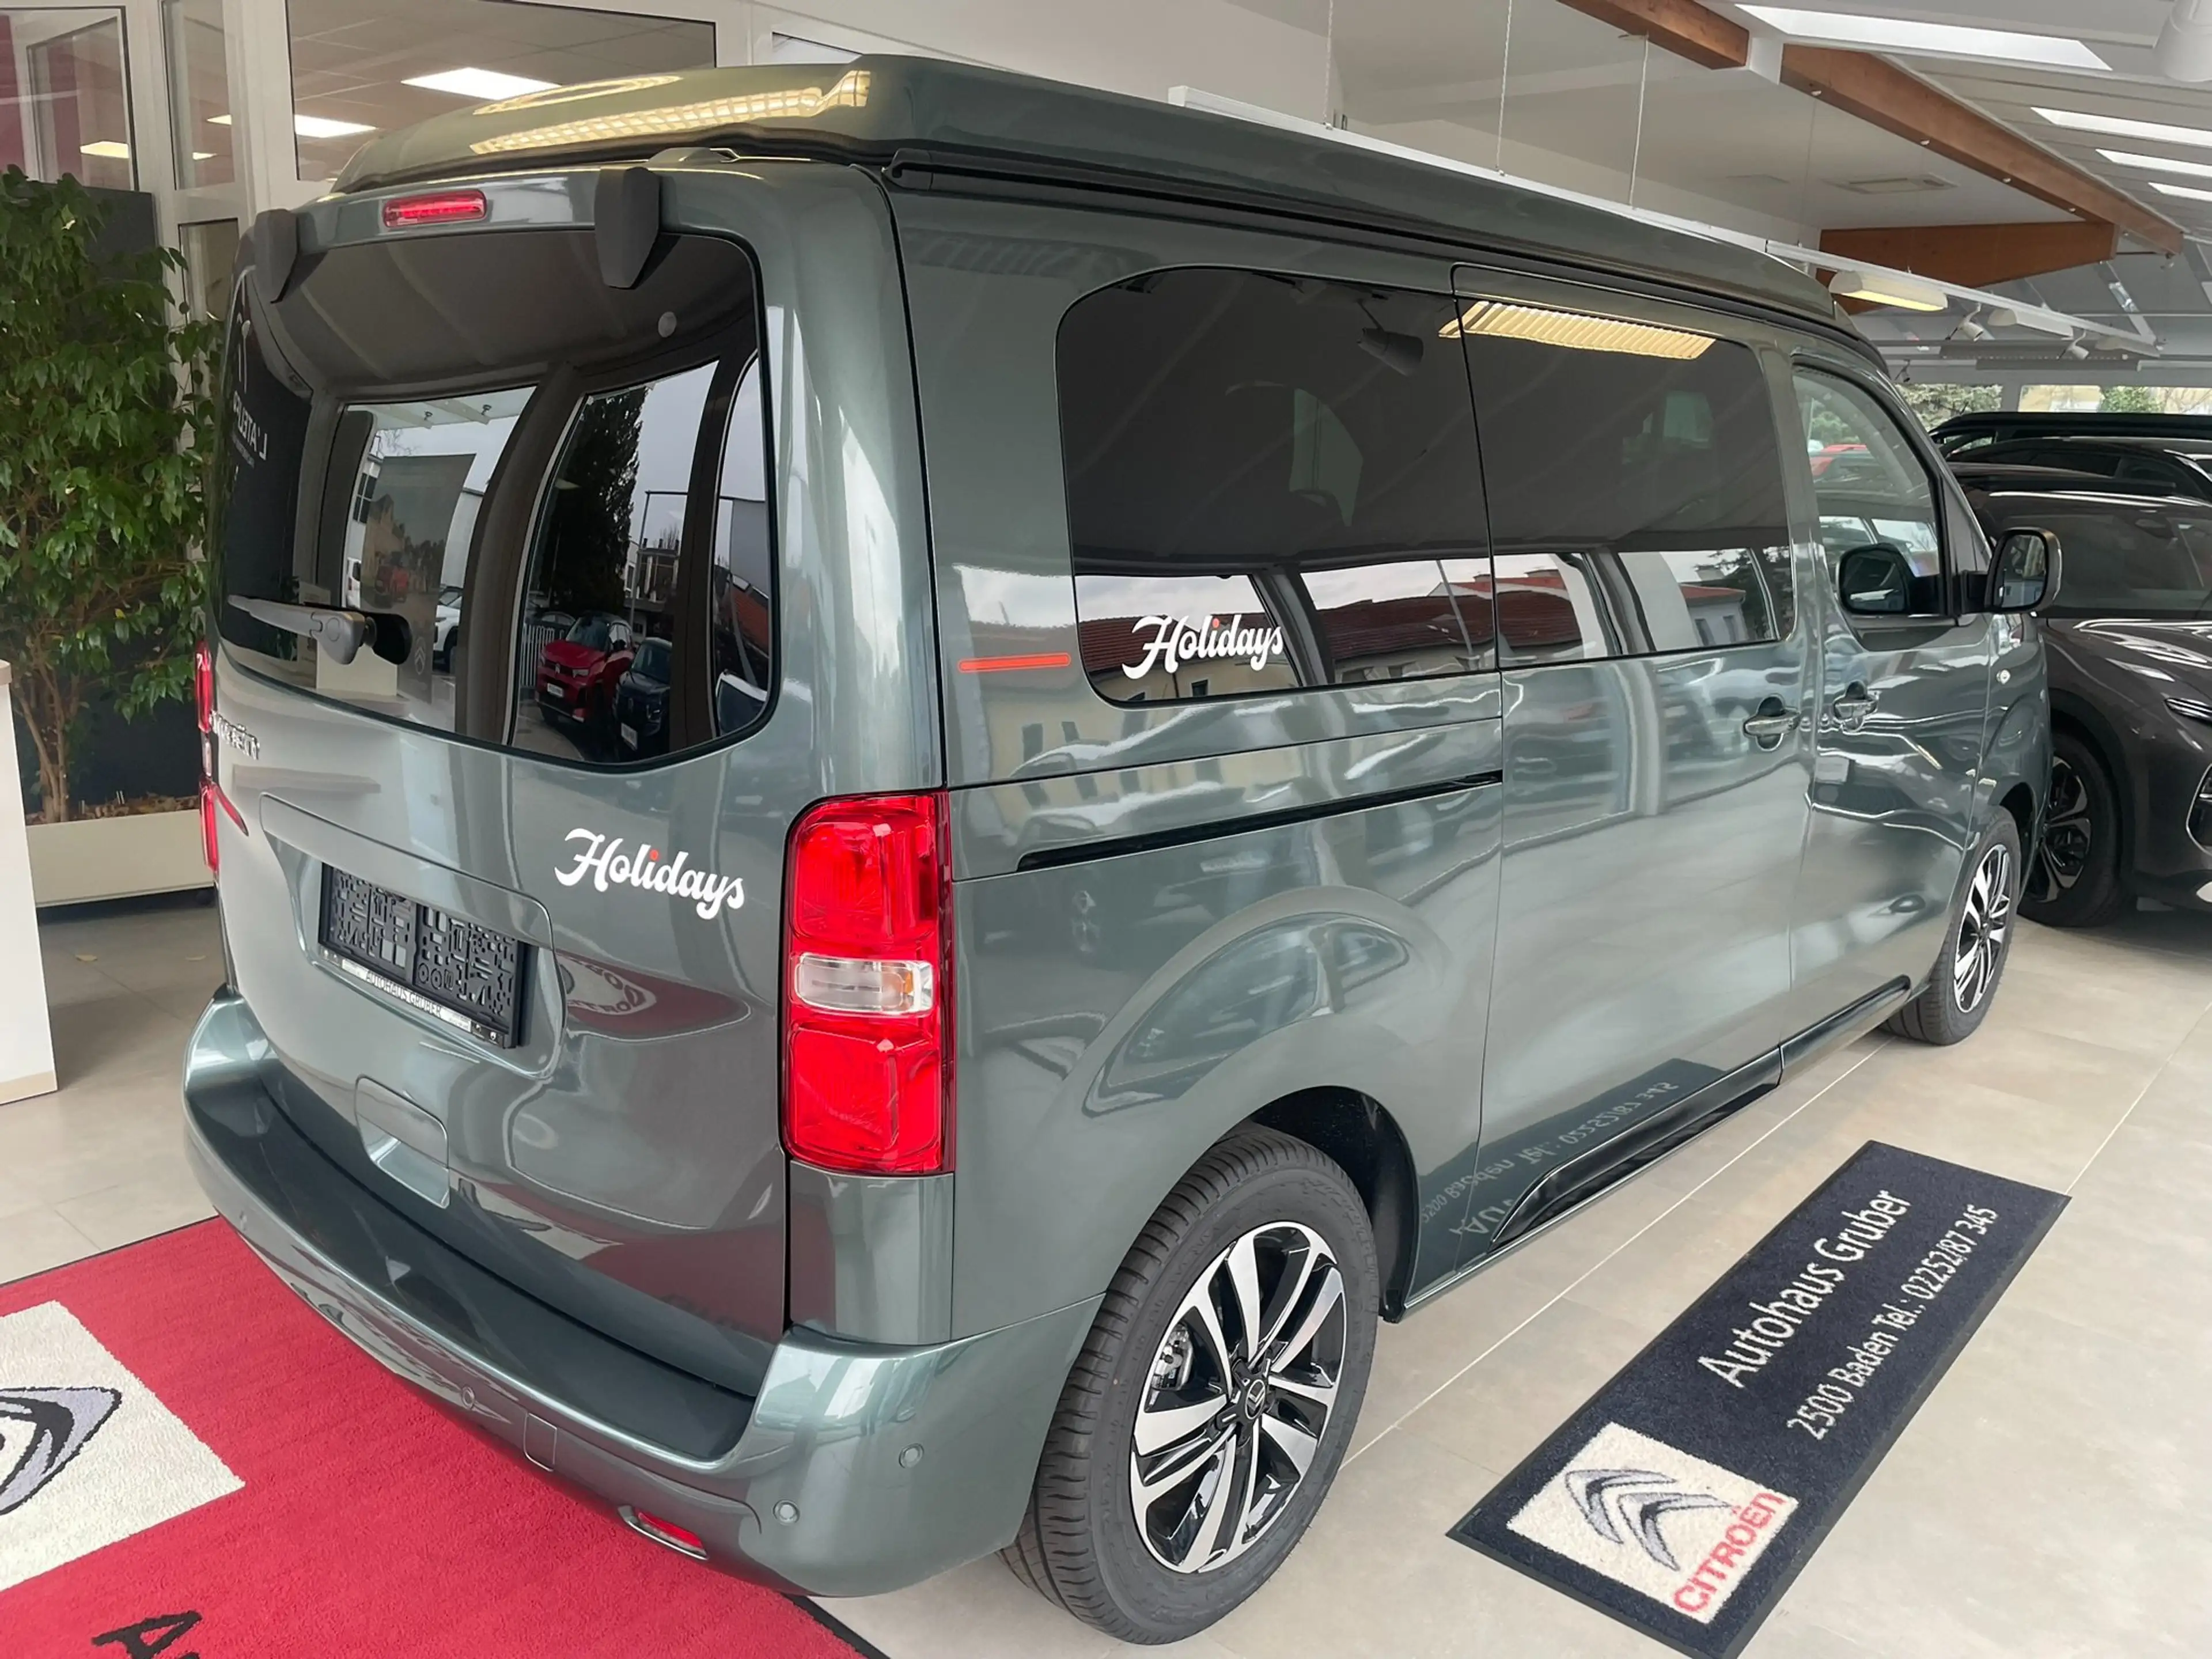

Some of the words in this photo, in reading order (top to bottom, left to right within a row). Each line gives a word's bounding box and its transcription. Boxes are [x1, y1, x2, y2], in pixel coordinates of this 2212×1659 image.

[1122, 614, 1283, 680] Holidays
[555, 828, 745, 920] Holidays
[1698, 1262, 1844, 1389] Autohaus
[1814, 1190, 1911, 1263] Gruber
[1786, 1382, 1855, 1441] 2500
[1827, 1330, 1899, 1388] Baden
[1954, 1203, 1999, 1236] 345
[1672, 1492, 1787, 1612] CITROËN
